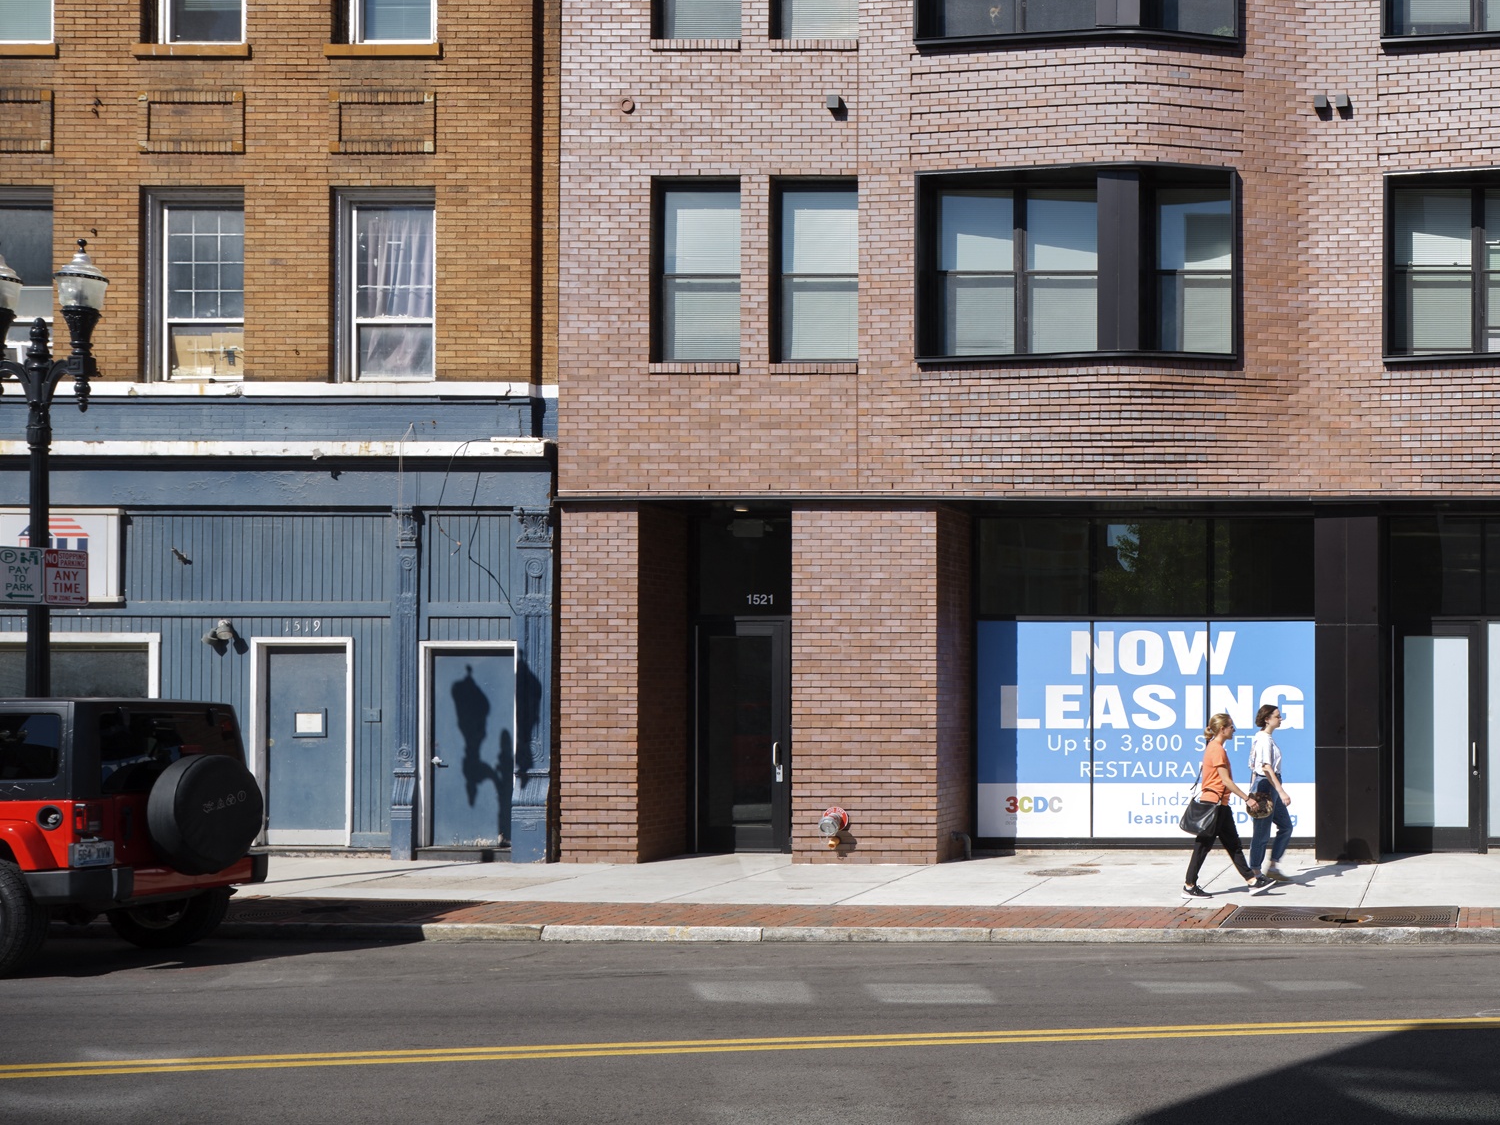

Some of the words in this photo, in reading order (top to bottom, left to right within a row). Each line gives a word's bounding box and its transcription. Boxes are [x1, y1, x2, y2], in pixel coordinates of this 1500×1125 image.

[45, 553, 58, 564] NO
[58, 552, 86, 560] STOPPING
[8, 566, 30, 574] PAY
[54, 570, 79, 581] ANY
[5, 583, 33, 591] PARK
[52, 582, 81, 593] TIME
[746, 594, 774, 605] 1521
[285, 620, 321, 632] 1519
[1070, 630, 1236, 675] NOW
[1000, 684, 1305, 729] LEASING
[1047, 734, 1078, 756] Up
[1083, 735, 1107, 752] to
[1120, 734, 1183, 755] 3,800
[1004, 796, 1063, 813] 3CDC
[78, 848, 92, 860] 564
